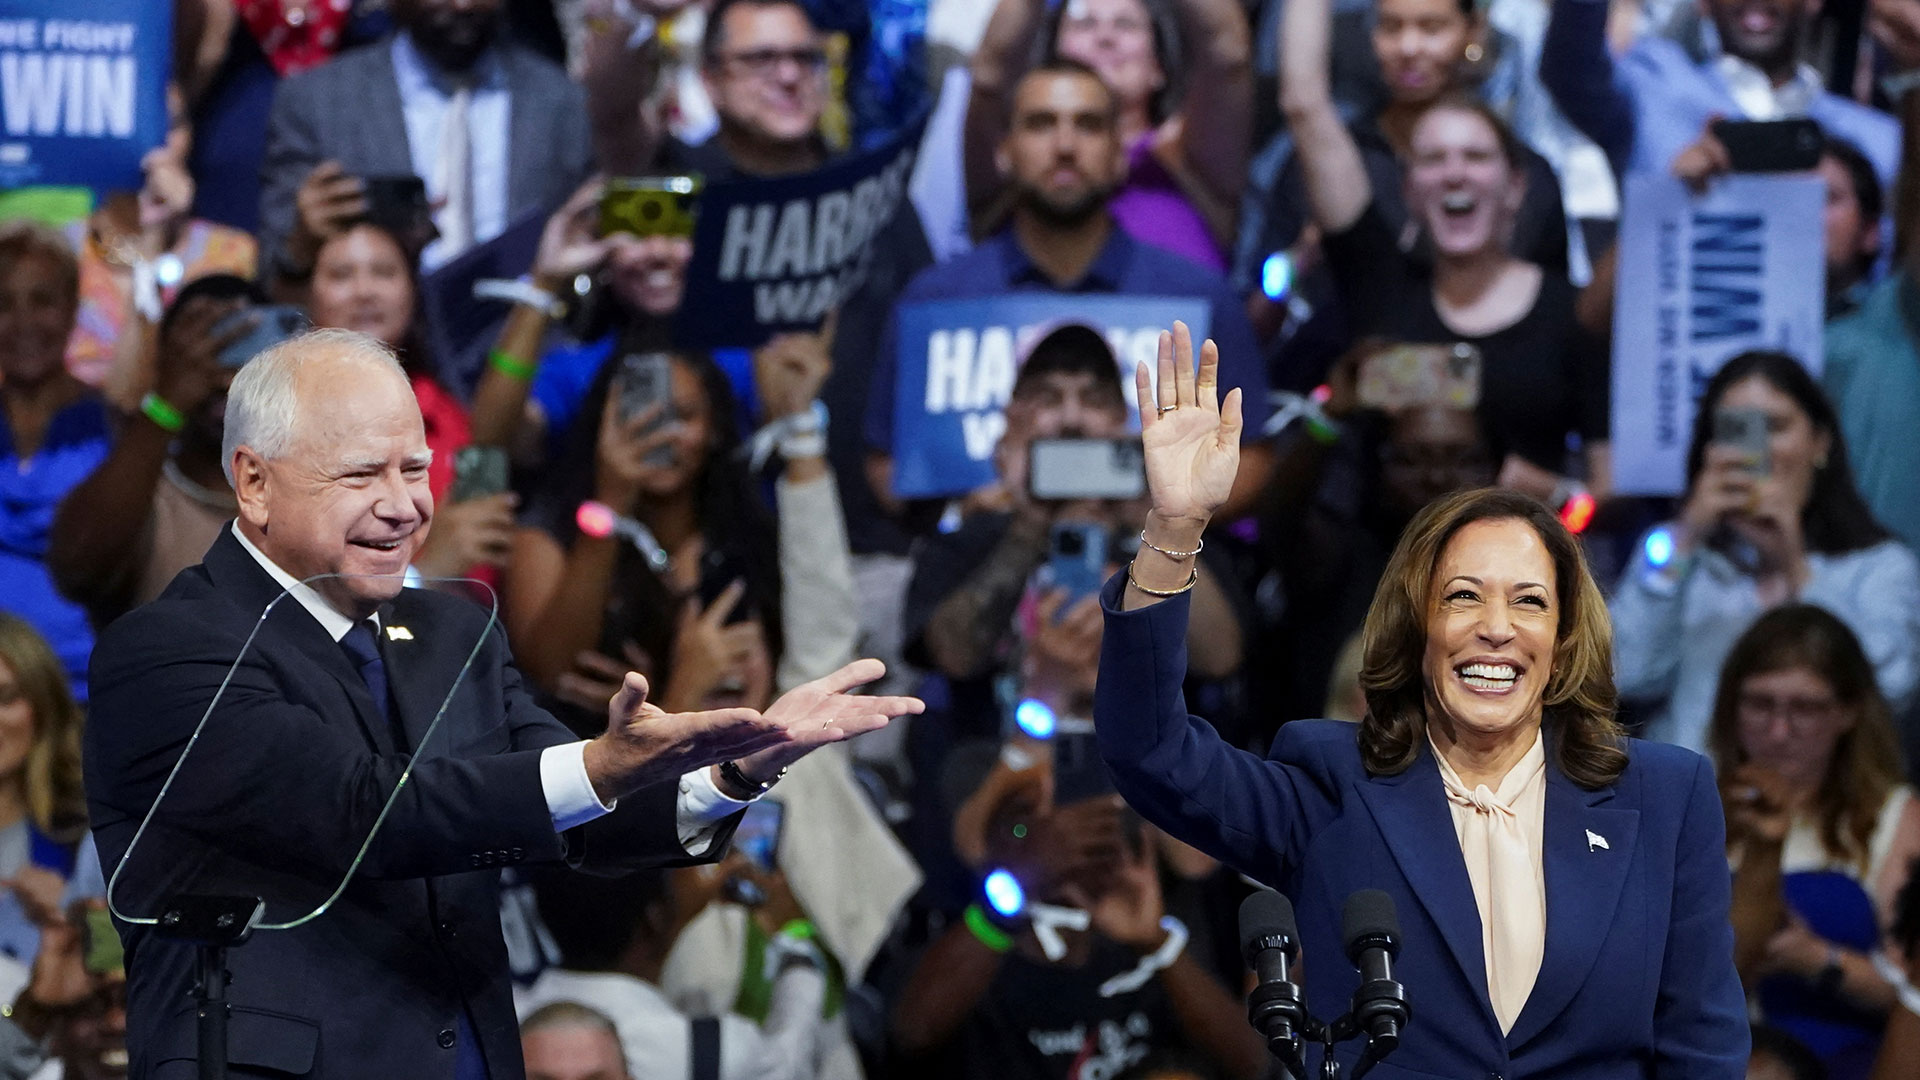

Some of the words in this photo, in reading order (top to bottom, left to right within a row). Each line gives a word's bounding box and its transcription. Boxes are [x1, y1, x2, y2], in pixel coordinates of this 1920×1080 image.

[44, 20, 135, 50] FIGHT
[1, 52, 135, 137] WIN
[718, 152, 911, 281] HARR
[755, 255, 860, 323] WA
[1693, 213, 1763, 341] WIN
[1656, 308, 1679, 350] WE
